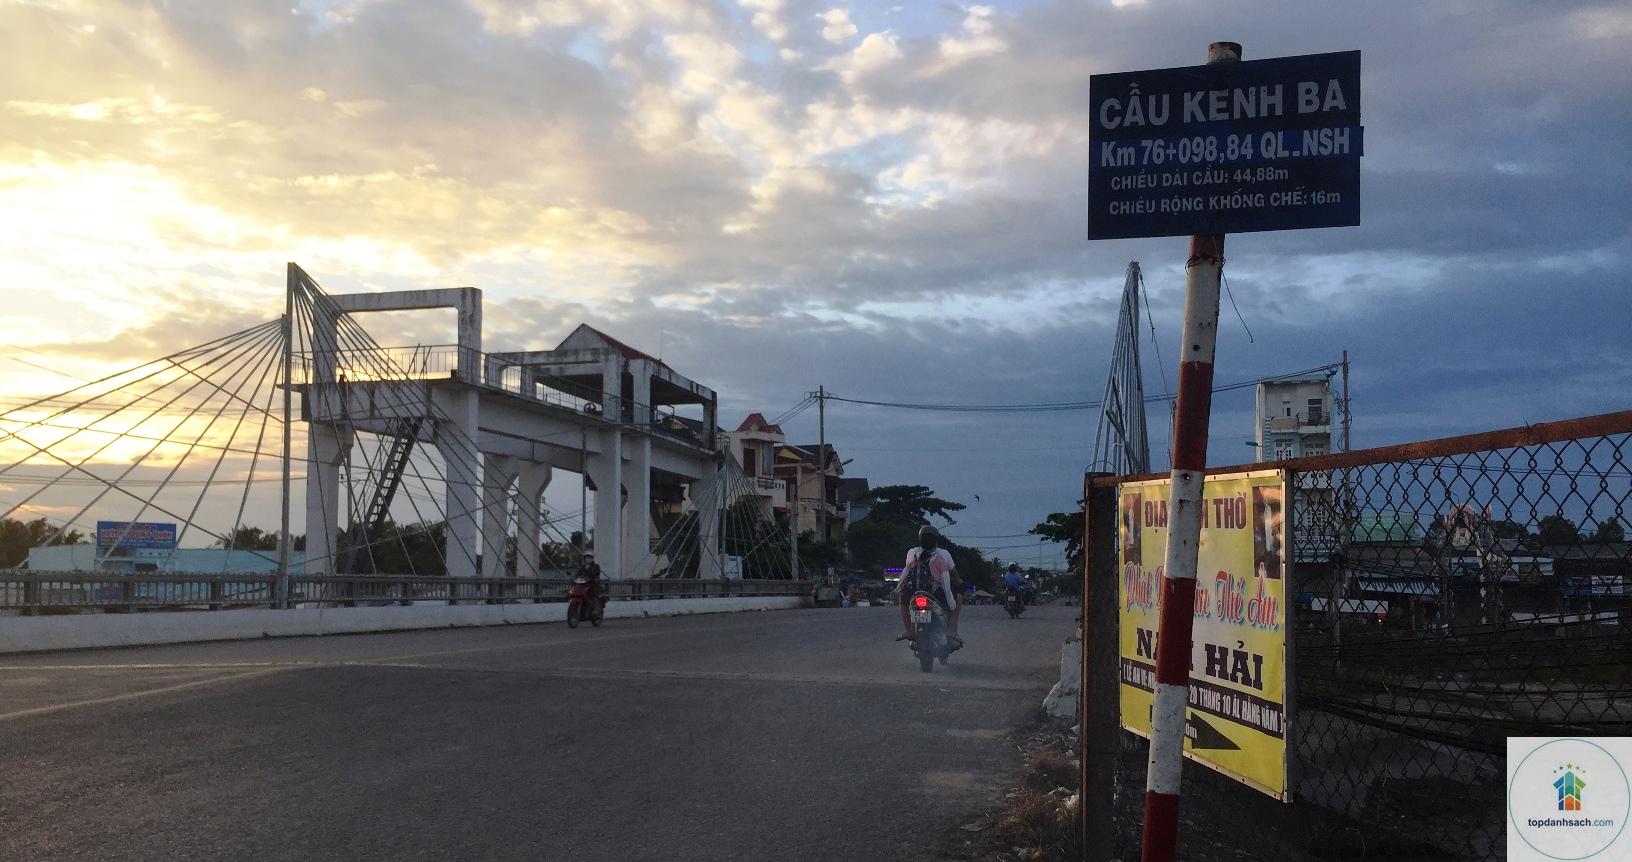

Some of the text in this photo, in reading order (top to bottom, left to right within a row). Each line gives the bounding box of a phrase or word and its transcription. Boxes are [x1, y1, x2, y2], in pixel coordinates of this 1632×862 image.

[1100, 78, 1347, 130] CẦU KENH BA
[1101, 141, 1136, 167] Km
[1141, 133, 1254, 166] 76+098,84
[1233, 166, 1289, 186] 44,88m
[1160, 194, 1204, 217] RỘNG
[1213, 491, 1247, 530] THỜ
[1204, 639, 1264, 691] HẢI
[1199, 687, 1221, 713] THÁNG
[1223, 694, 1231, 715] 10
